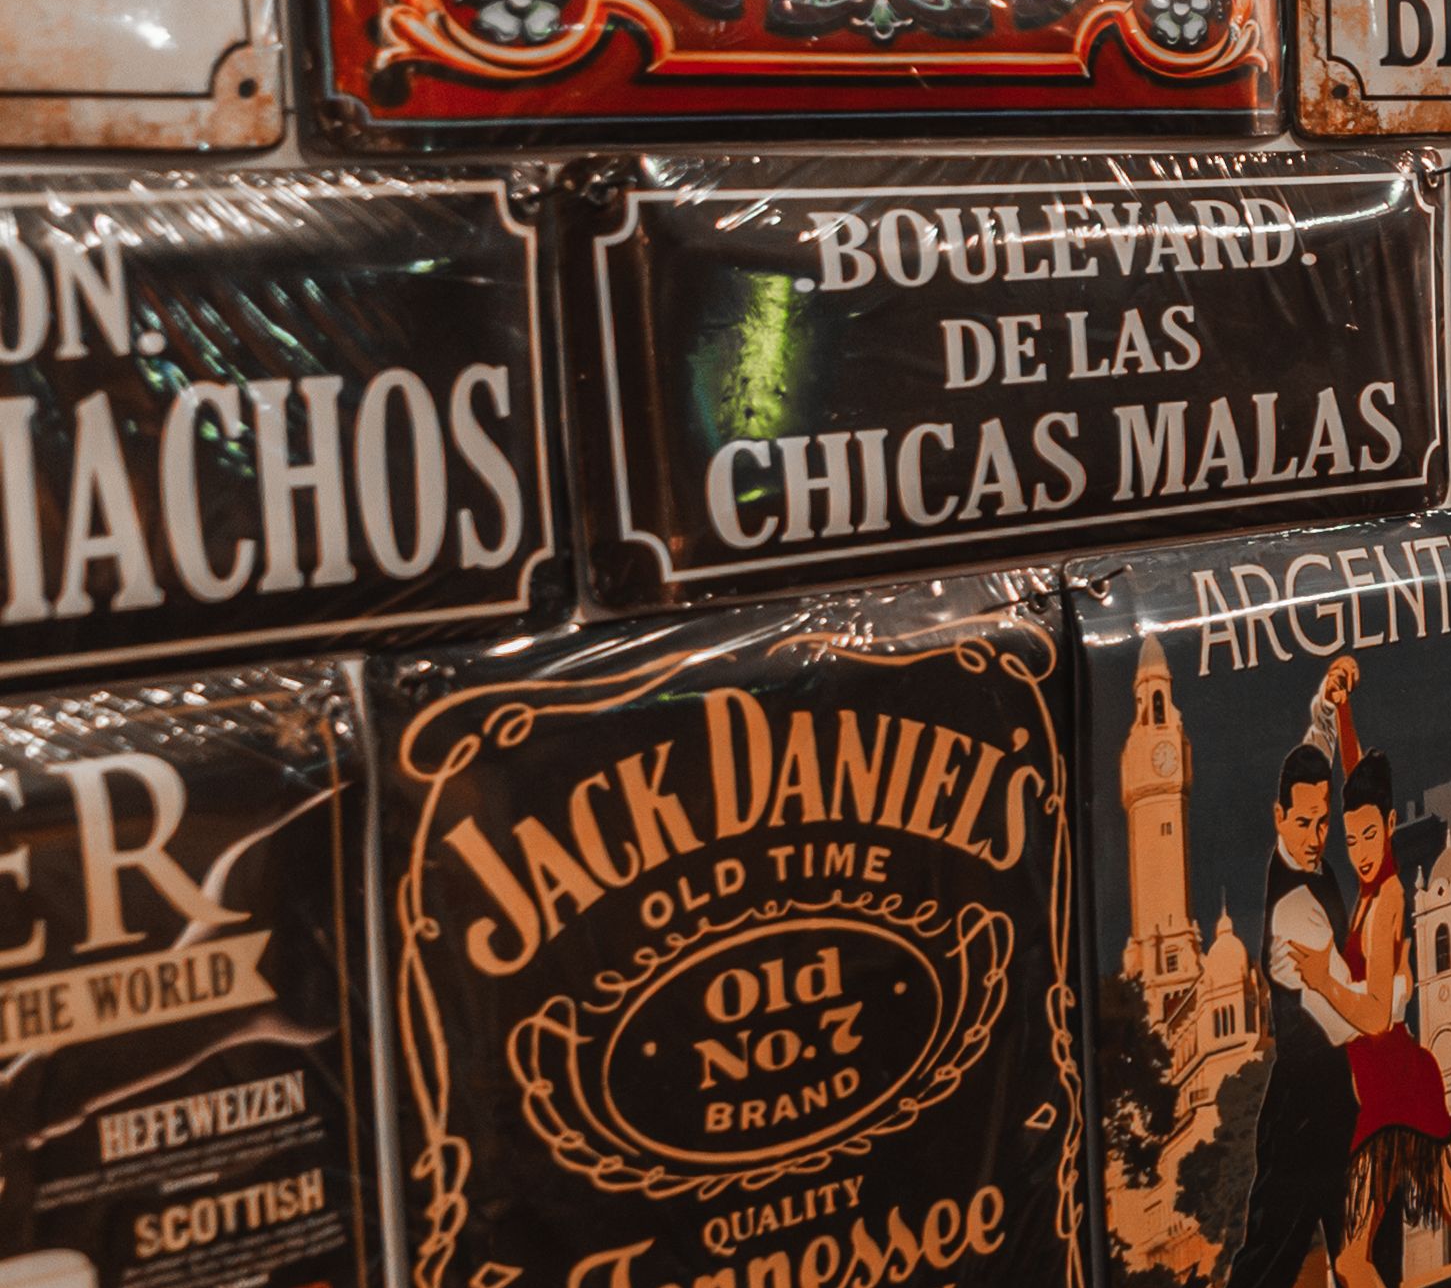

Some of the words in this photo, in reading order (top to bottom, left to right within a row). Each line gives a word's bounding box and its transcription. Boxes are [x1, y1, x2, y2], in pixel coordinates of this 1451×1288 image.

[943, 315, 1048, 392] DE
[1069, 303, 1202, 381] LAS
[706, 417, 1097, 553] CHICAS
[1111, 382, 1401, 503] MALAS
[444, 739, 705, 976] JACK
[703, 687, 1046, 871] DANIEL'S
[641, 858, 746, 930] OLD
[768, 844, 892, 885] TIME
[87, 950, 235, 1021] WORLD
[704, 946, 842, 1023] Old
[101, 1070, 306, 1164] HEFEWEIZEN
[706, 1067, 861, 1133] BRAND
[134, 1166, 325, 1260] SCOTTISH
[702, 1175, 865, 1254] QUALITY
